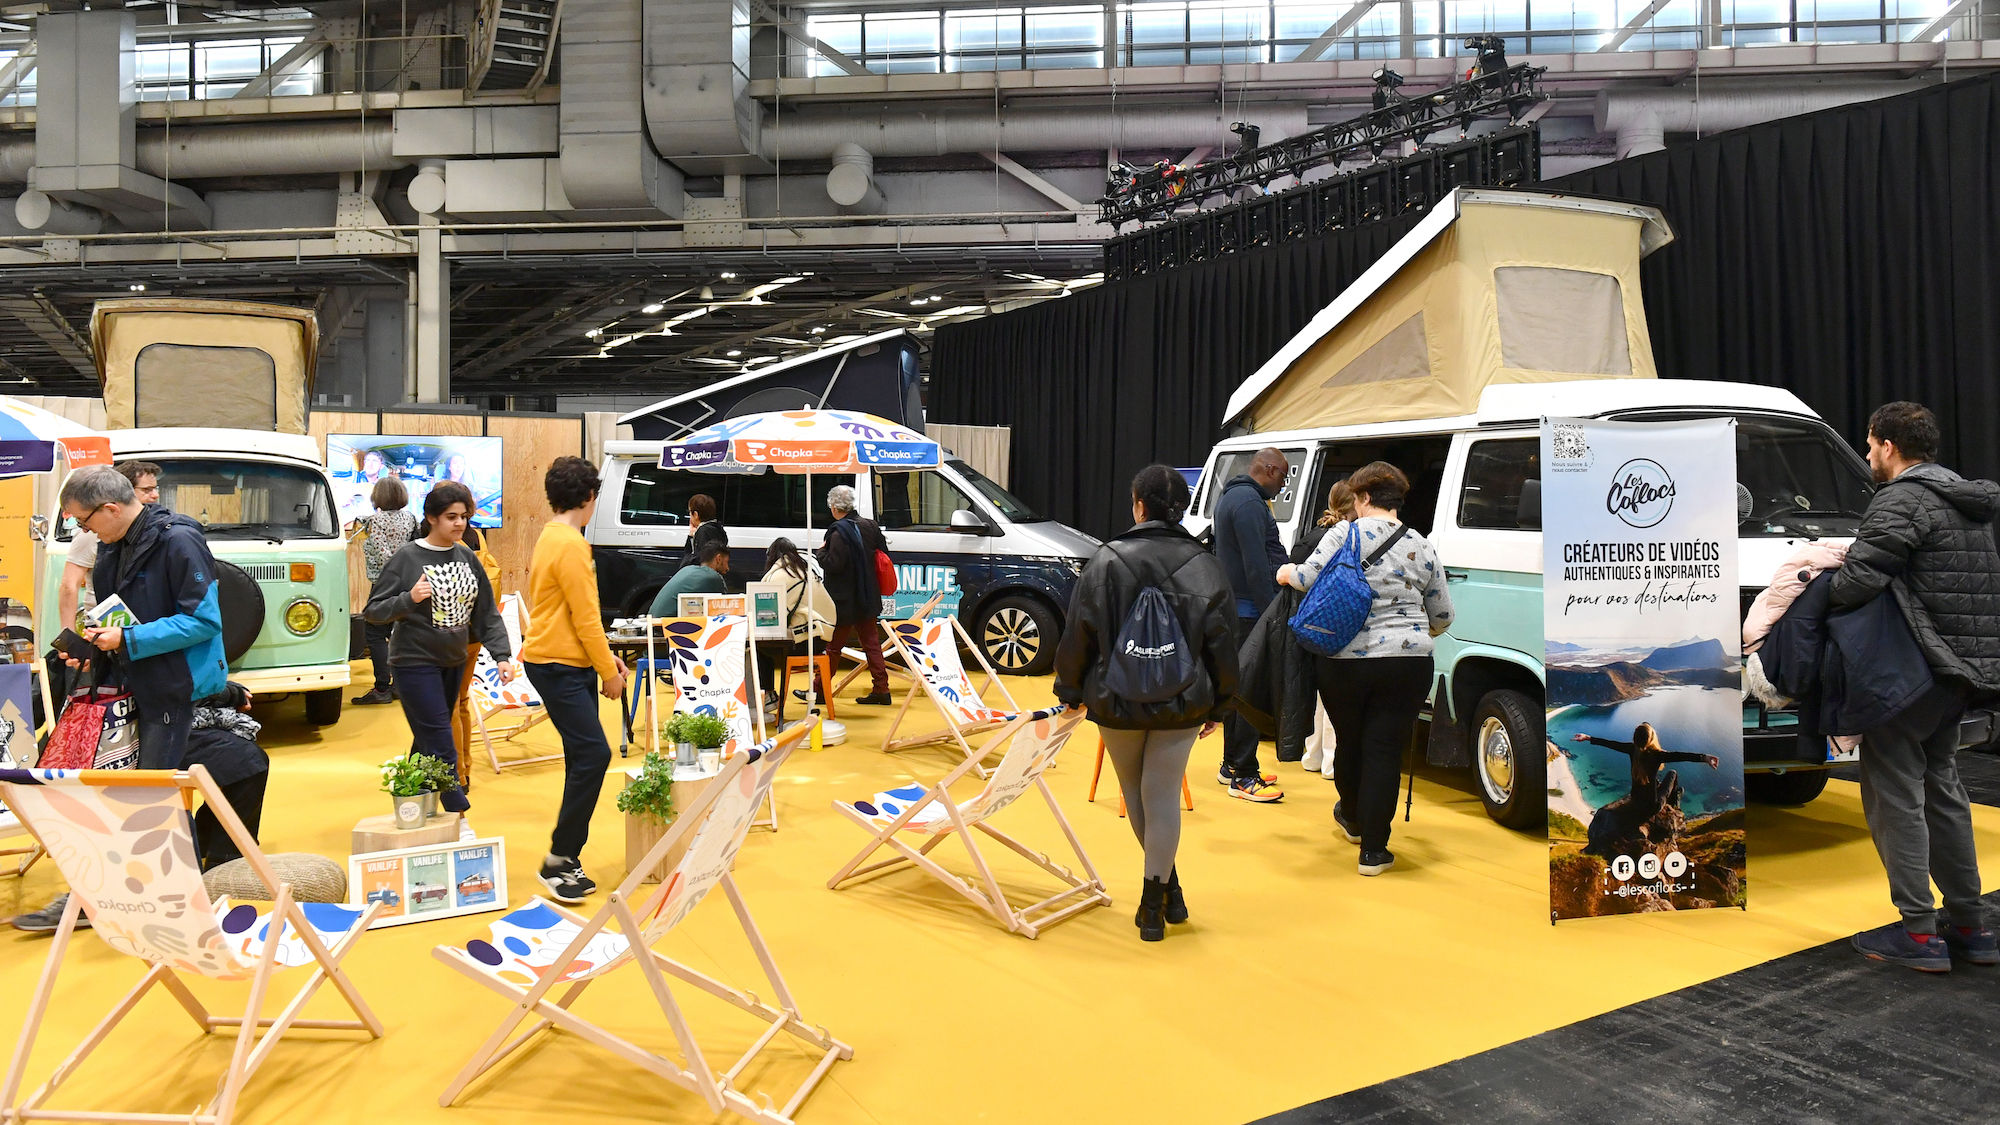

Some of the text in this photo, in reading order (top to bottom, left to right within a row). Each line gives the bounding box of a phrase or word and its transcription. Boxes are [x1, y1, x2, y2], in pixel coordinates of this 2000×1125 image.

[686, 450, 711, 461] Chapka
[770, 447, 813, 459] Chapka
[878, 449, 911, 460] Chapka
[1624, 473, 1643, 489] Les
[1607, 480, 1676, 515] Coflocs
[1564, 538, 1719, 563] CRÉATEURS DE VIDÉOS
[894, 567, 956, 591] NLIFE
[1564, 564, 1720, 581] AUTHENTIQUES & INSPIRANTES
[712, 600, 739, 609] VANLIFE
[1564, 580, 1720, 616] pour vos destinations
[700, 688, 731, 697] Chapka
[412, 854, 443, 867] VANLIFE
[459, 848, 488, 861] VANLIFE
[367, 860, 398, 873] VANLIFE
[1618, 881, 1681, 898] @lescoflocs
